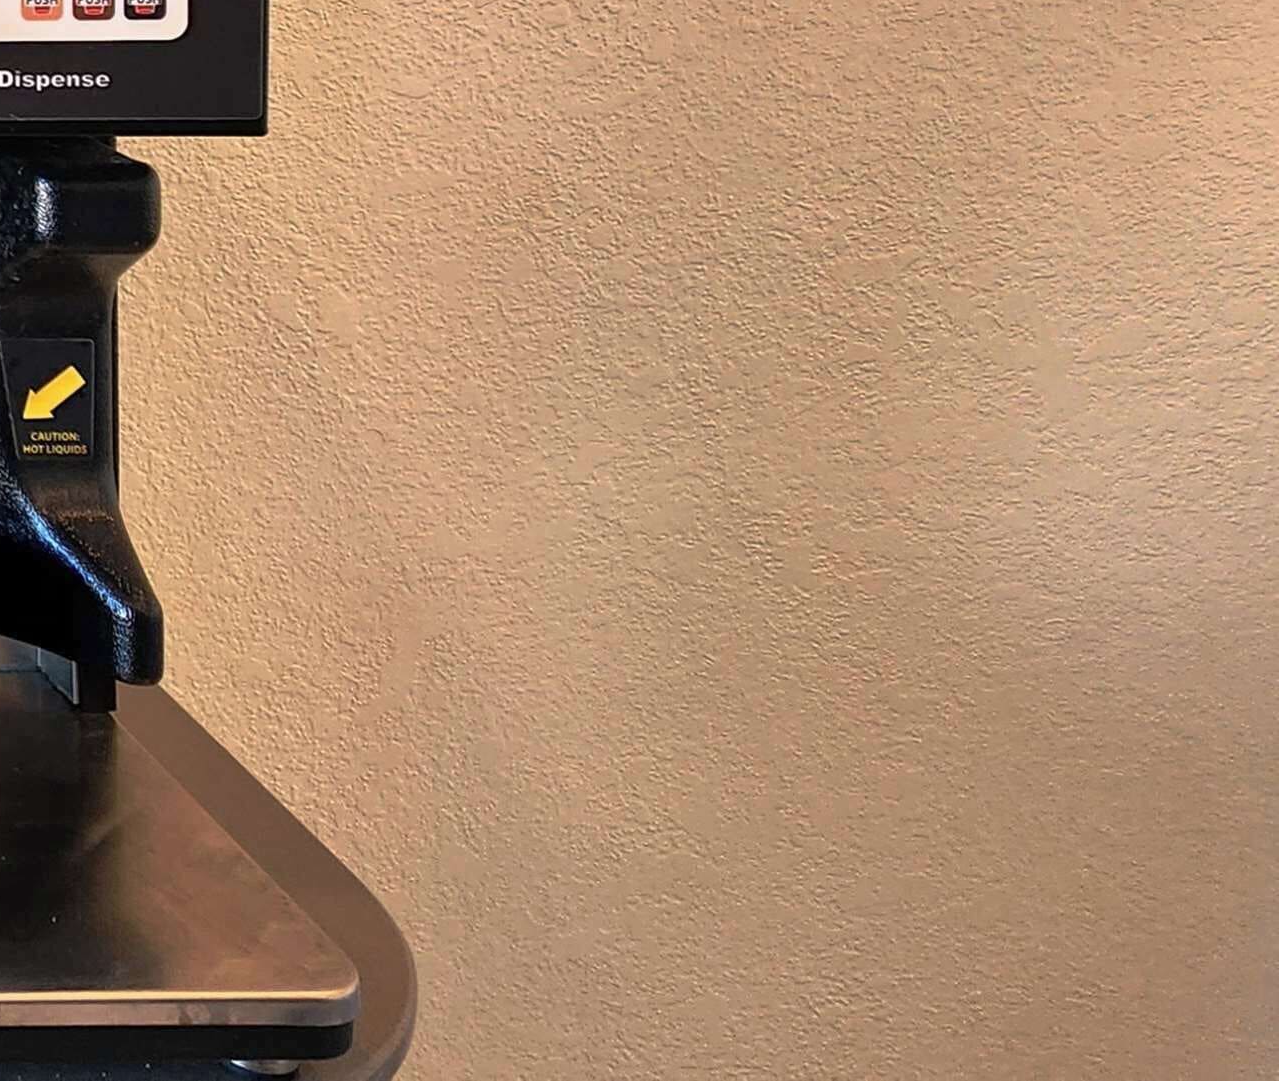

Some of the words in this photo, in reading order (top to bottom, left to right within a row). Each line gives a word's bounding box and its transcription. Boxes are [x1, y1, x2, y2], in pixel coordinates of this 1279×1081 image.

[30, 431, 81, 441] CAUTION:
[22, 444, 45, 454] HOT
[45, 444, 88, 455] LIQUIDS
